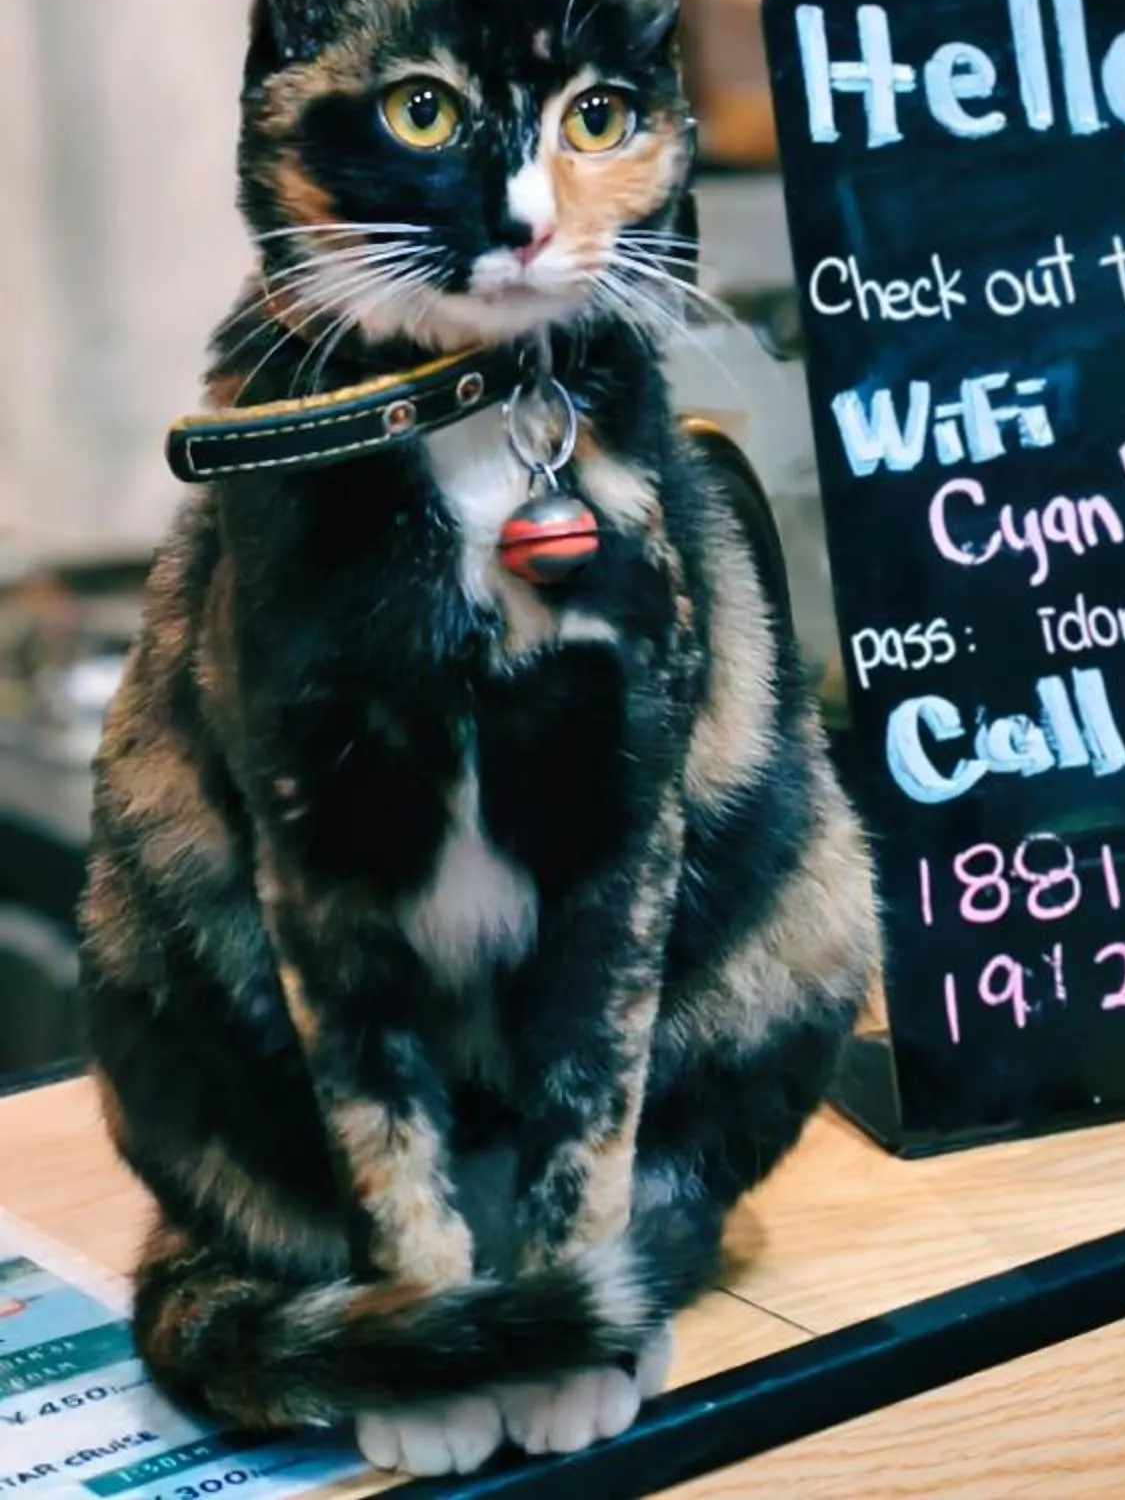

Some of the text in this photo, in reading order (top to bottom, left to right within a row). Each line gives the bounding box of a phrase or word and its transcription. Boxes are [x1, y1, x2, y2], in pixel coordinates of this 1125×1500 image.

[810, 254, 966, 321] Check
[985, 235, 1075, 316] out
[832, 373, 1056, 477] WiFi
[0, 1463, 60, 1491] TAR
